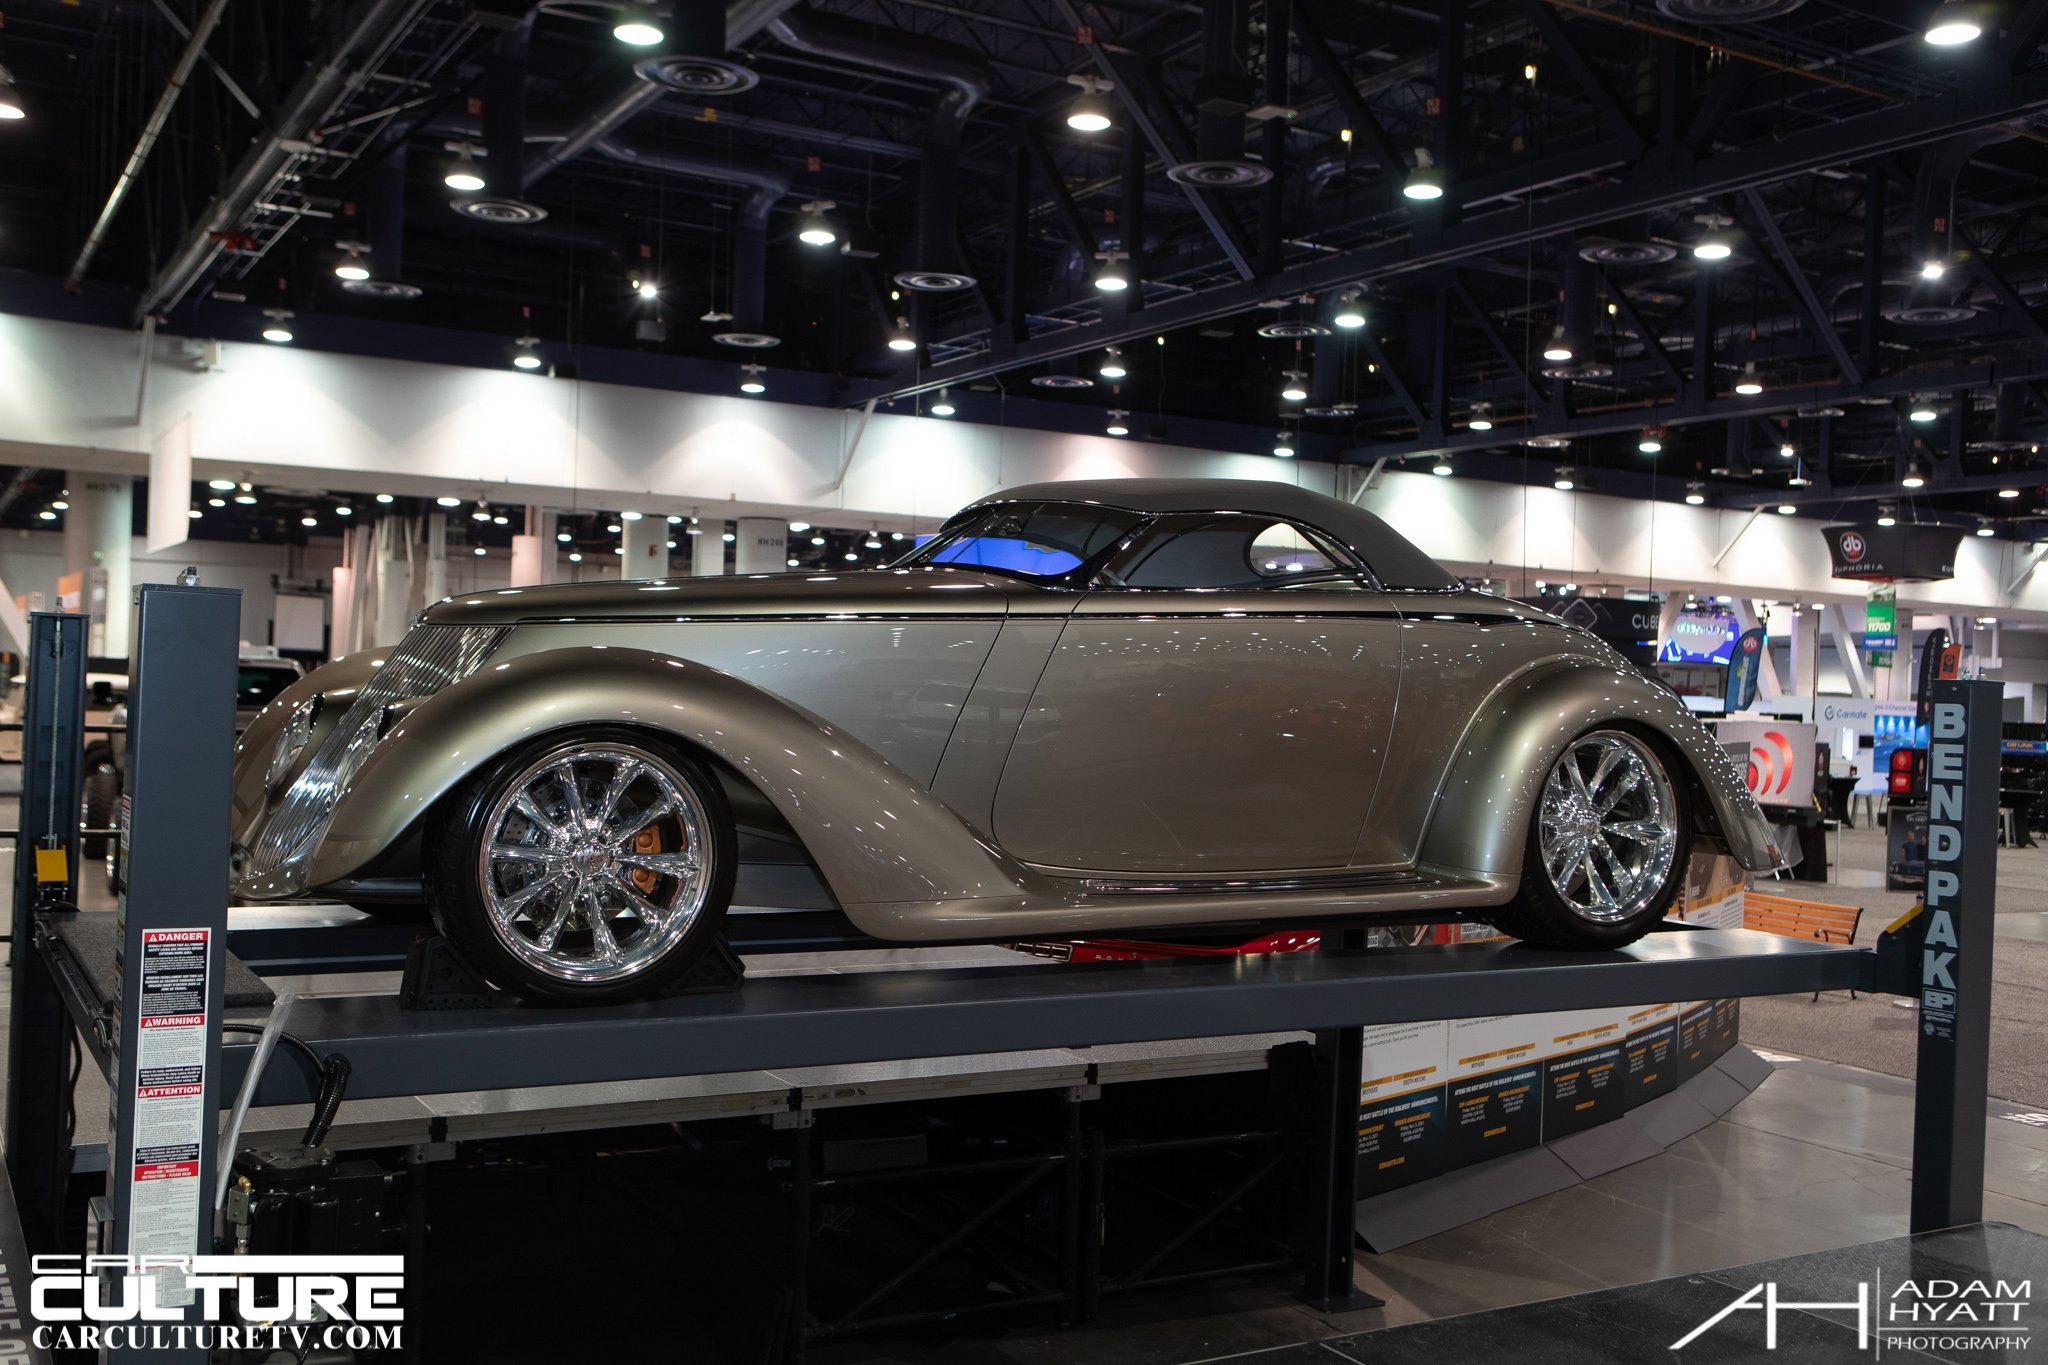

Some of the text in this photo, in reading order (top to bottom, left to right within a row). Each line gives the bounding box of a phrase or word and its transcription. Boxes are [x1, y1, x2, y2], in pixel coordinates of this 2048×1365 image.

[757, 537, 784, 546] NH2
[1922, 702, 1966, 990] BENDPAK
[158, 932, 204, 941] DANGER
[152, 1016, 201, 1026] WARNING
[147, 1086, 201, 1096] ATTENTION
